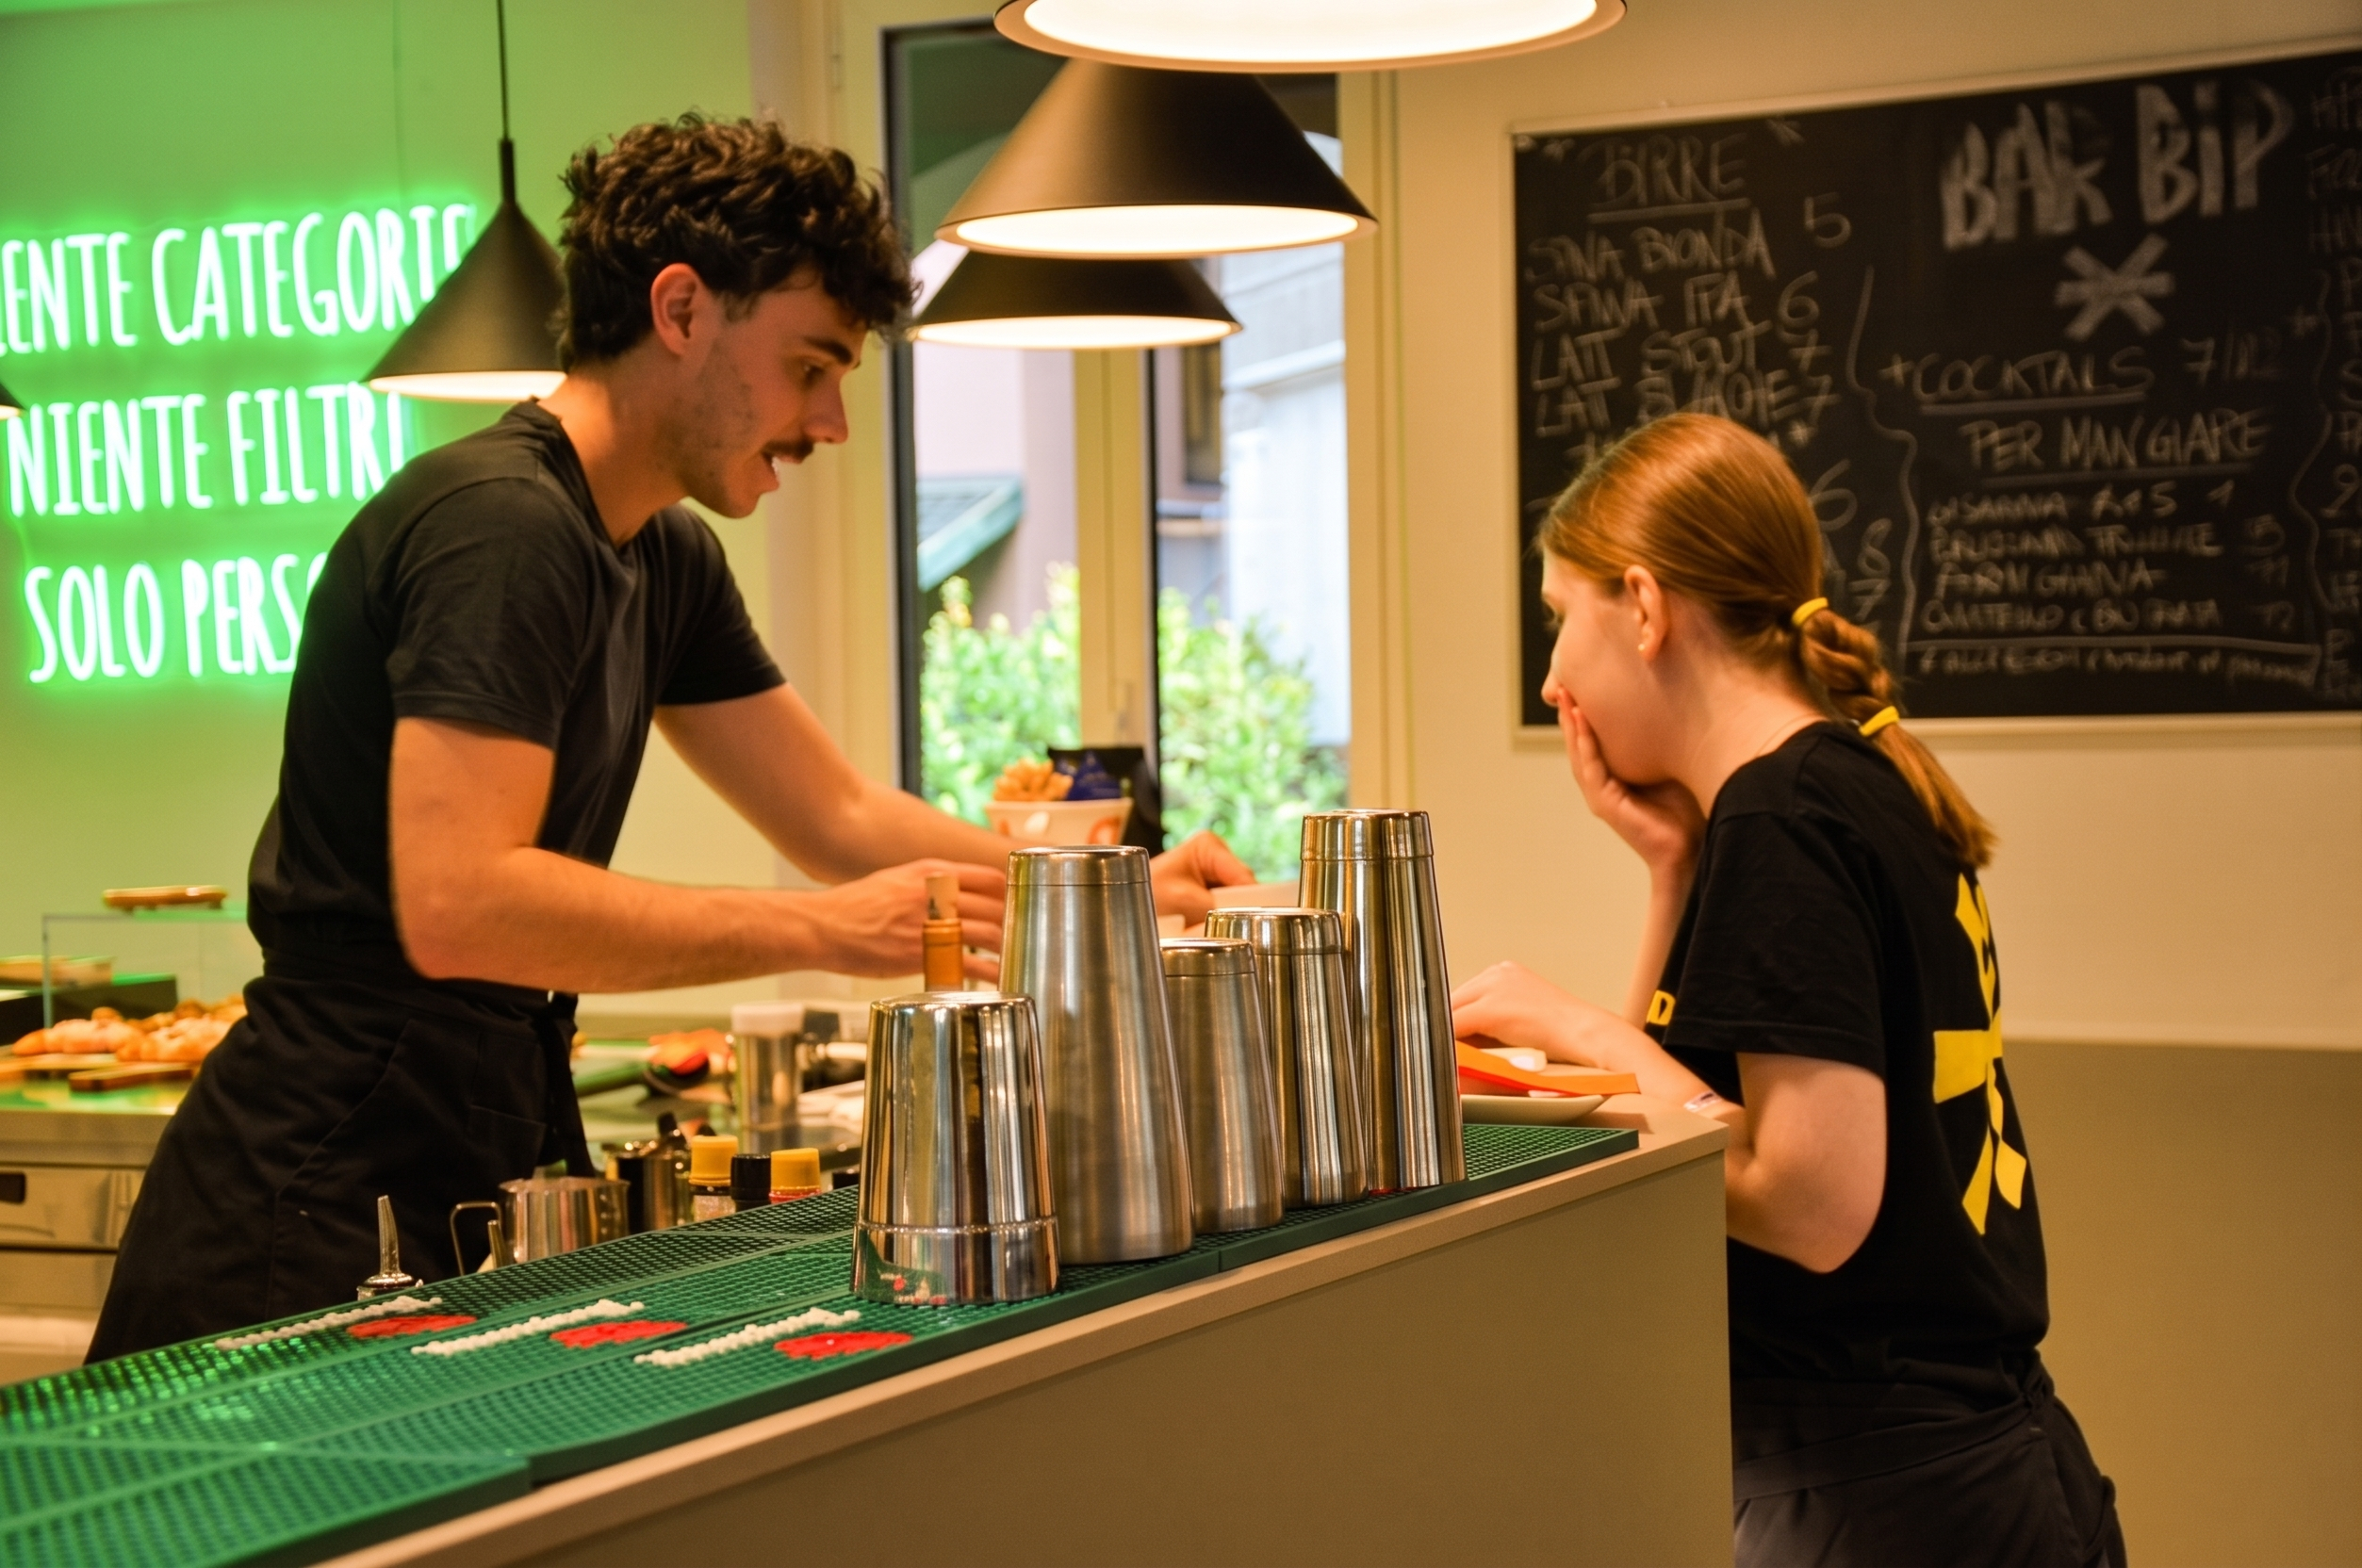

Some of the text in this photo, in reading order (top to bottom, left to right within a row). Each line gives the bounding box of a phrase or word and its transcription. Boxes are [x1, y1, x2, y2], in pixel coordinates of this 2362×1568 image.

[1802, 191, 1853, 250] 5
[1777, 270, 1821, 329] 6
[7, 391, 216, 518] NIENTE
[1958, 418, 2046, 472] PER
[2059, 407, 2273, 471] MANGIARE
[24, 559, 166, 684] SOLO
